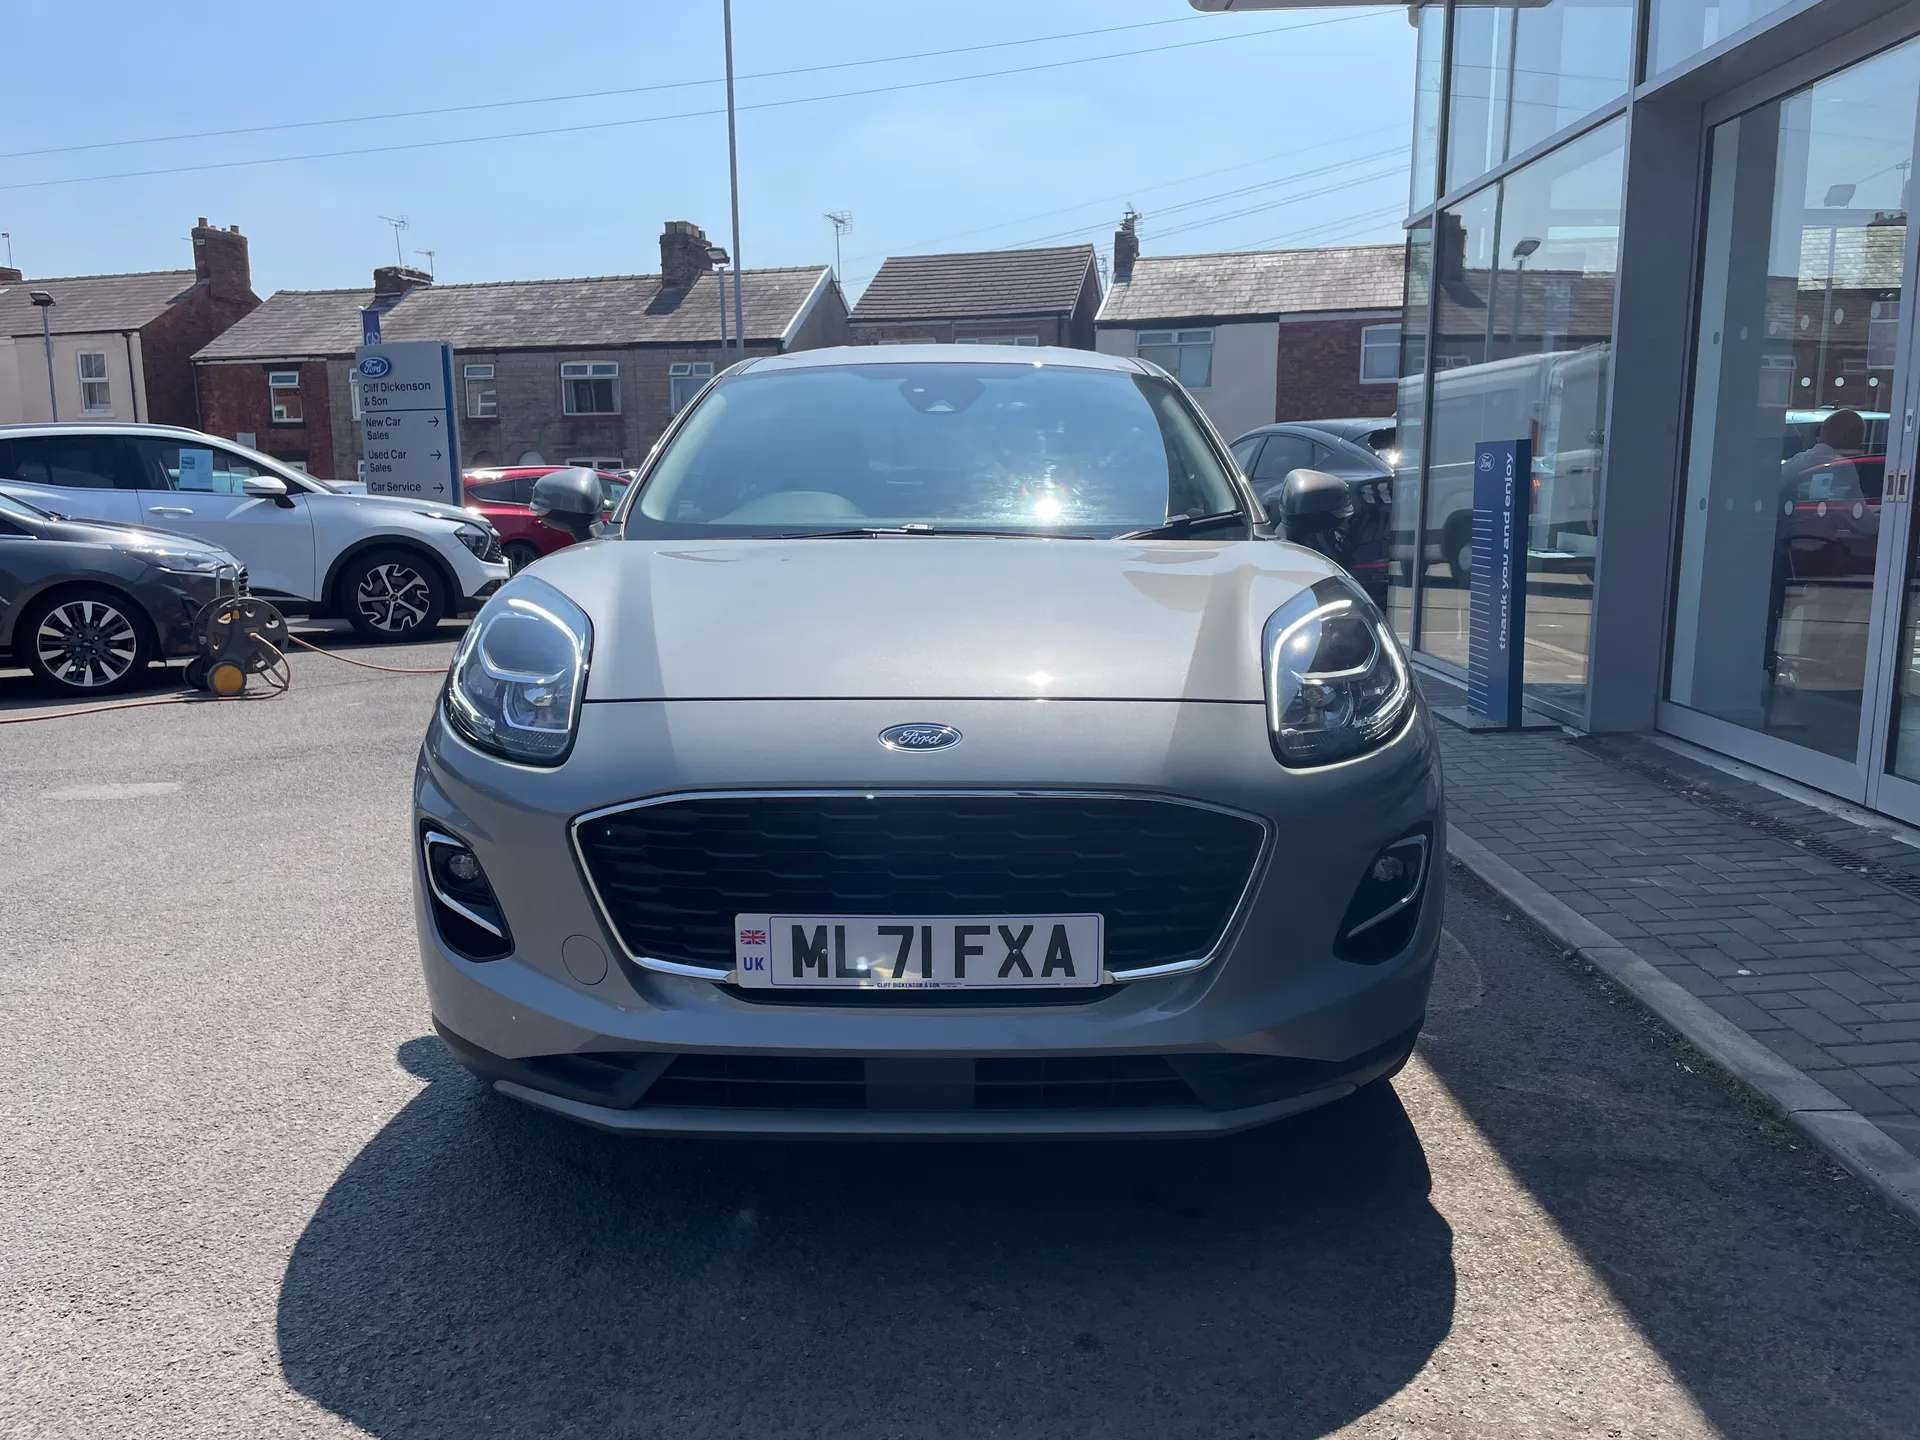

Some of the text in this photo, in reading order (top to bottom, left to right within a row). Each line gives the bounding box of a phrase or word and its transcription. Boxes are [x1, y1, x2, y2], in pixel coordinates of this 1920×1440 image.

[362, 359, 384, 374] Ford
[363, 381, 431, 394] Cliff Dickenson
[364, 395, 388, 407] & Son
[366, 416, 401, 428] New Car
[367, 430, 389, 441] Sales
[368, 449, 407, 460] Used Car
[369, 463, 392, 473] Sales
[371, 481, 421, 492] Car Service
[1499, 452, 1514, 650] thank you and enjoy
[897, 729, 943, 745] Ford
[790, 924, 1077, 979] ML71 FXA
[743, 957, 765, 971] UK
